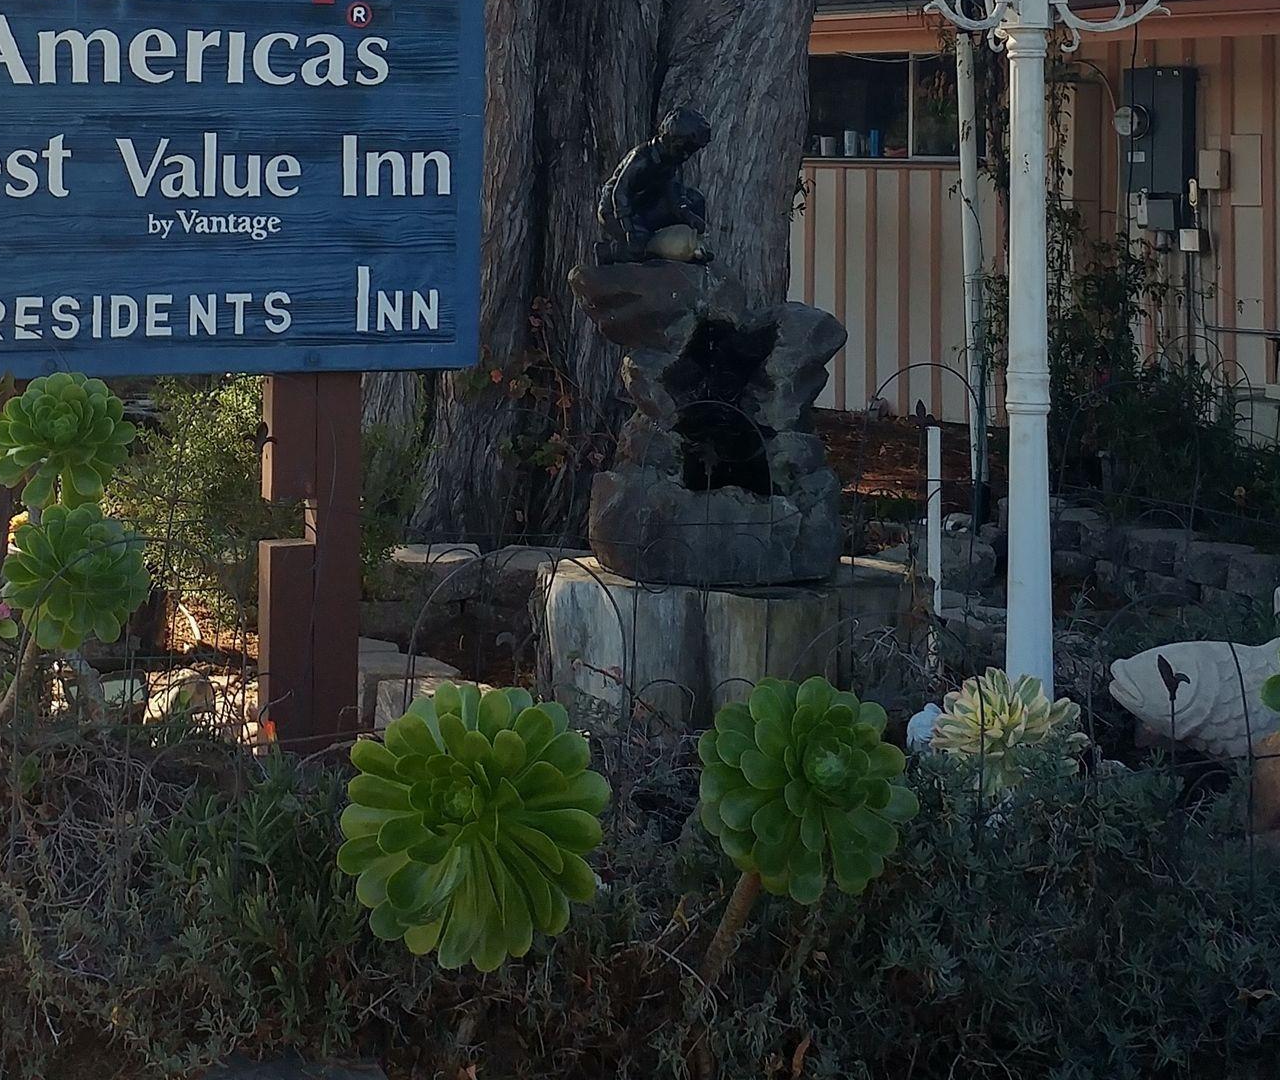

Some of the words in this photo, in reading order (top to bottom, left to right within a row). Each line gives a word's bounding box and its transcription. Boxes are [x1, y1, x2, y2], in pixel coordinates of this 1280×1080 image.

[115, 132, 301, 198] Value
[343, 134, 451, 197] Inn
[148, 213, 174, 239] by
[176, 209, 282, 241] Vantage
[356, 265, 439, 332] INN
